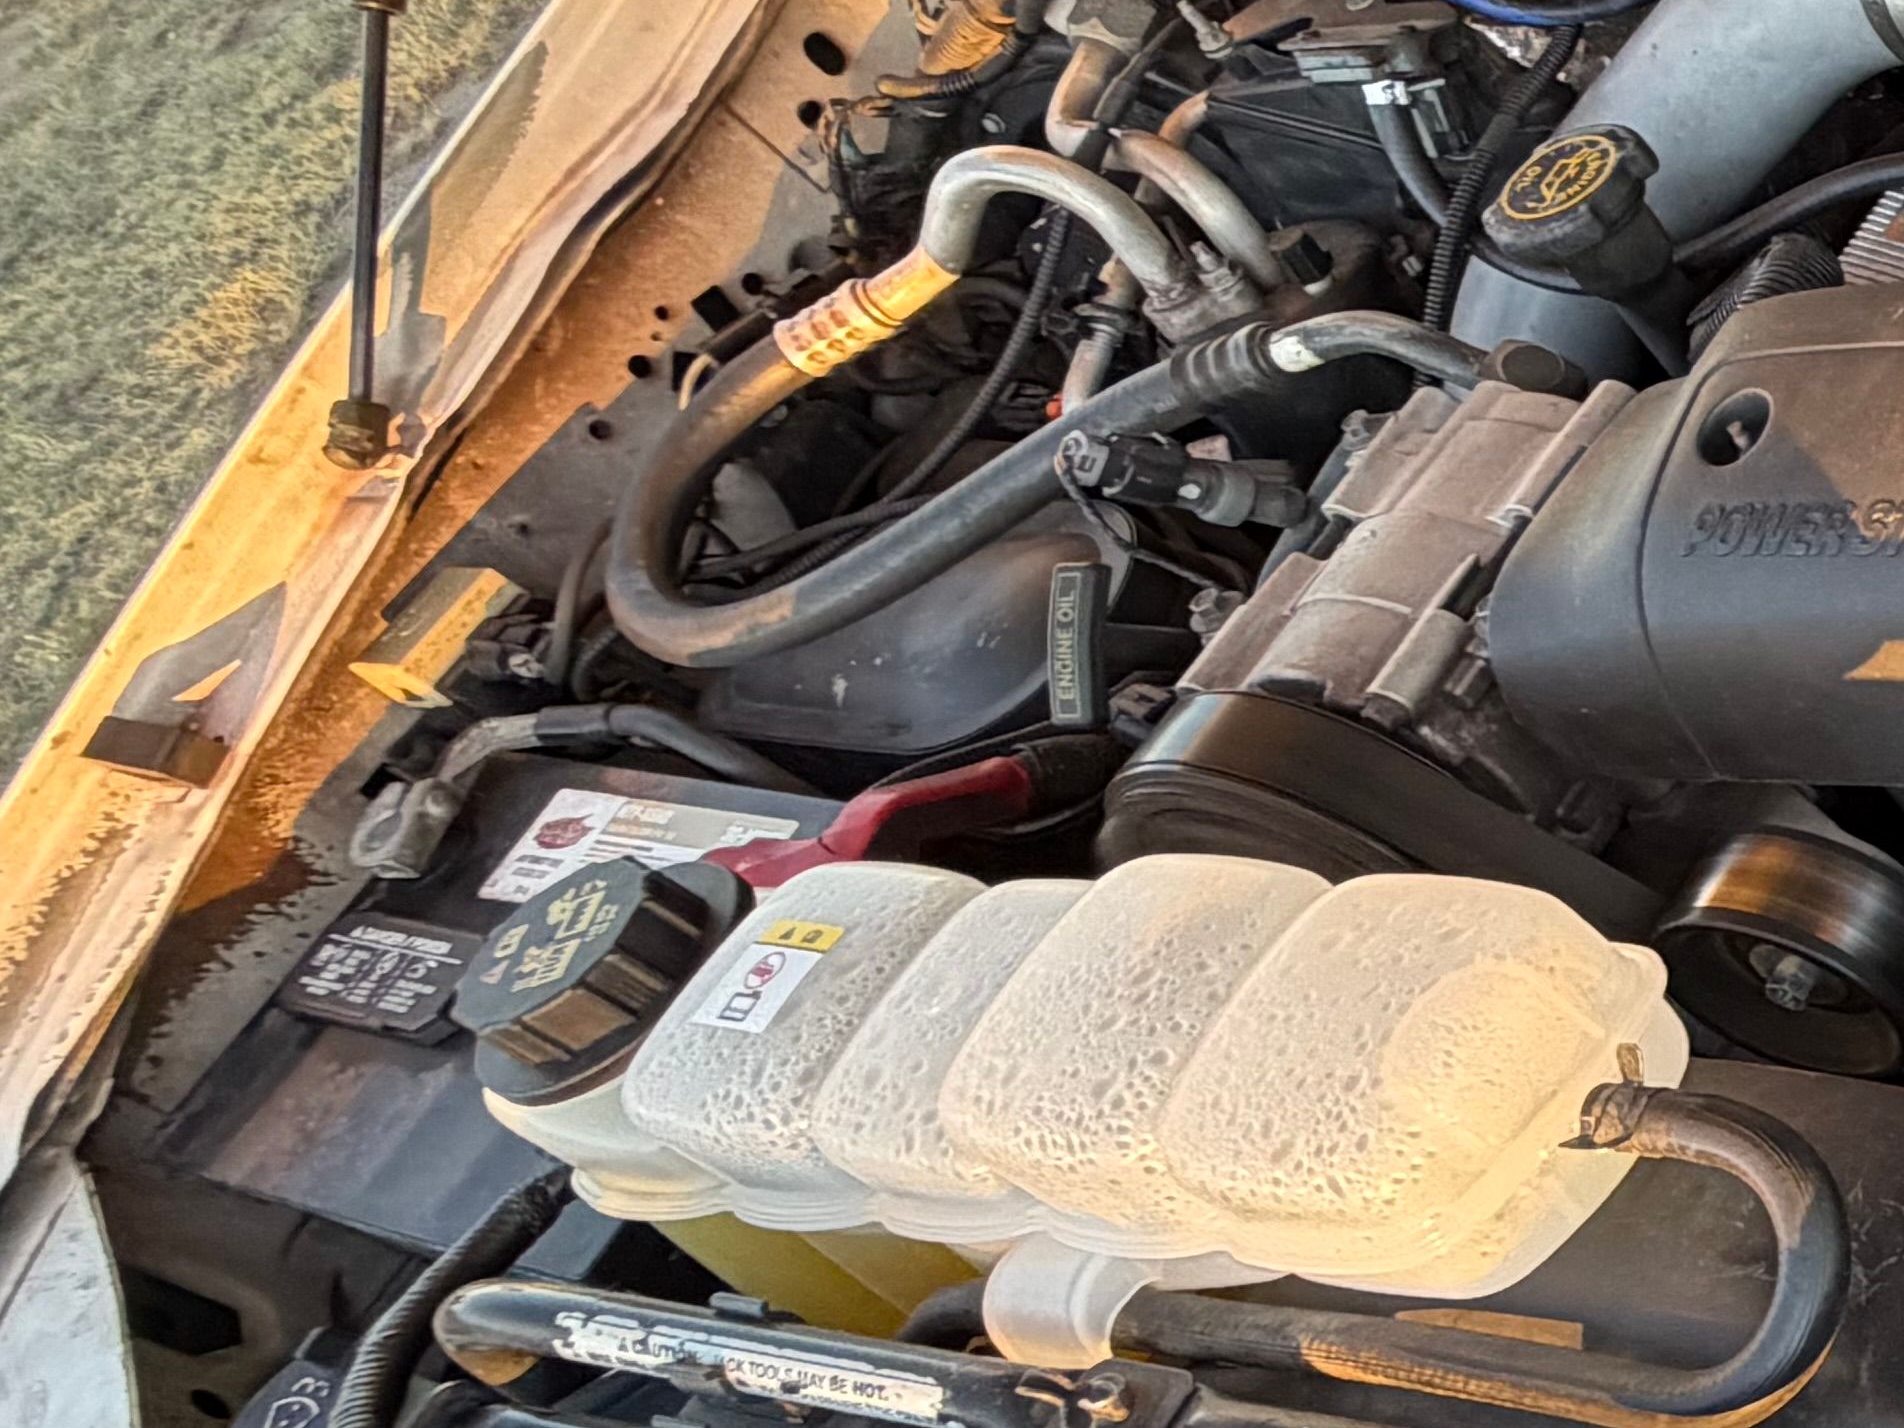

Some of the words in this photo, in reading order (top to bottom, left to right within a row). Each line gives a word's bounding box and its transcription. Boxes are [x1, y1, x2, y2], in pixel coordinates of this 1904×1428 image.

[1515, 166, 1541, 192] OIL
[1680, 500, 1858, 558] POWER
[1056, 590, 1074, 621] OIL
[1055, 626, 1073, 698] ENGINE
[746, 1360, 793, 1383] TOOLS
[827, 1374, 849, 1393] BE
